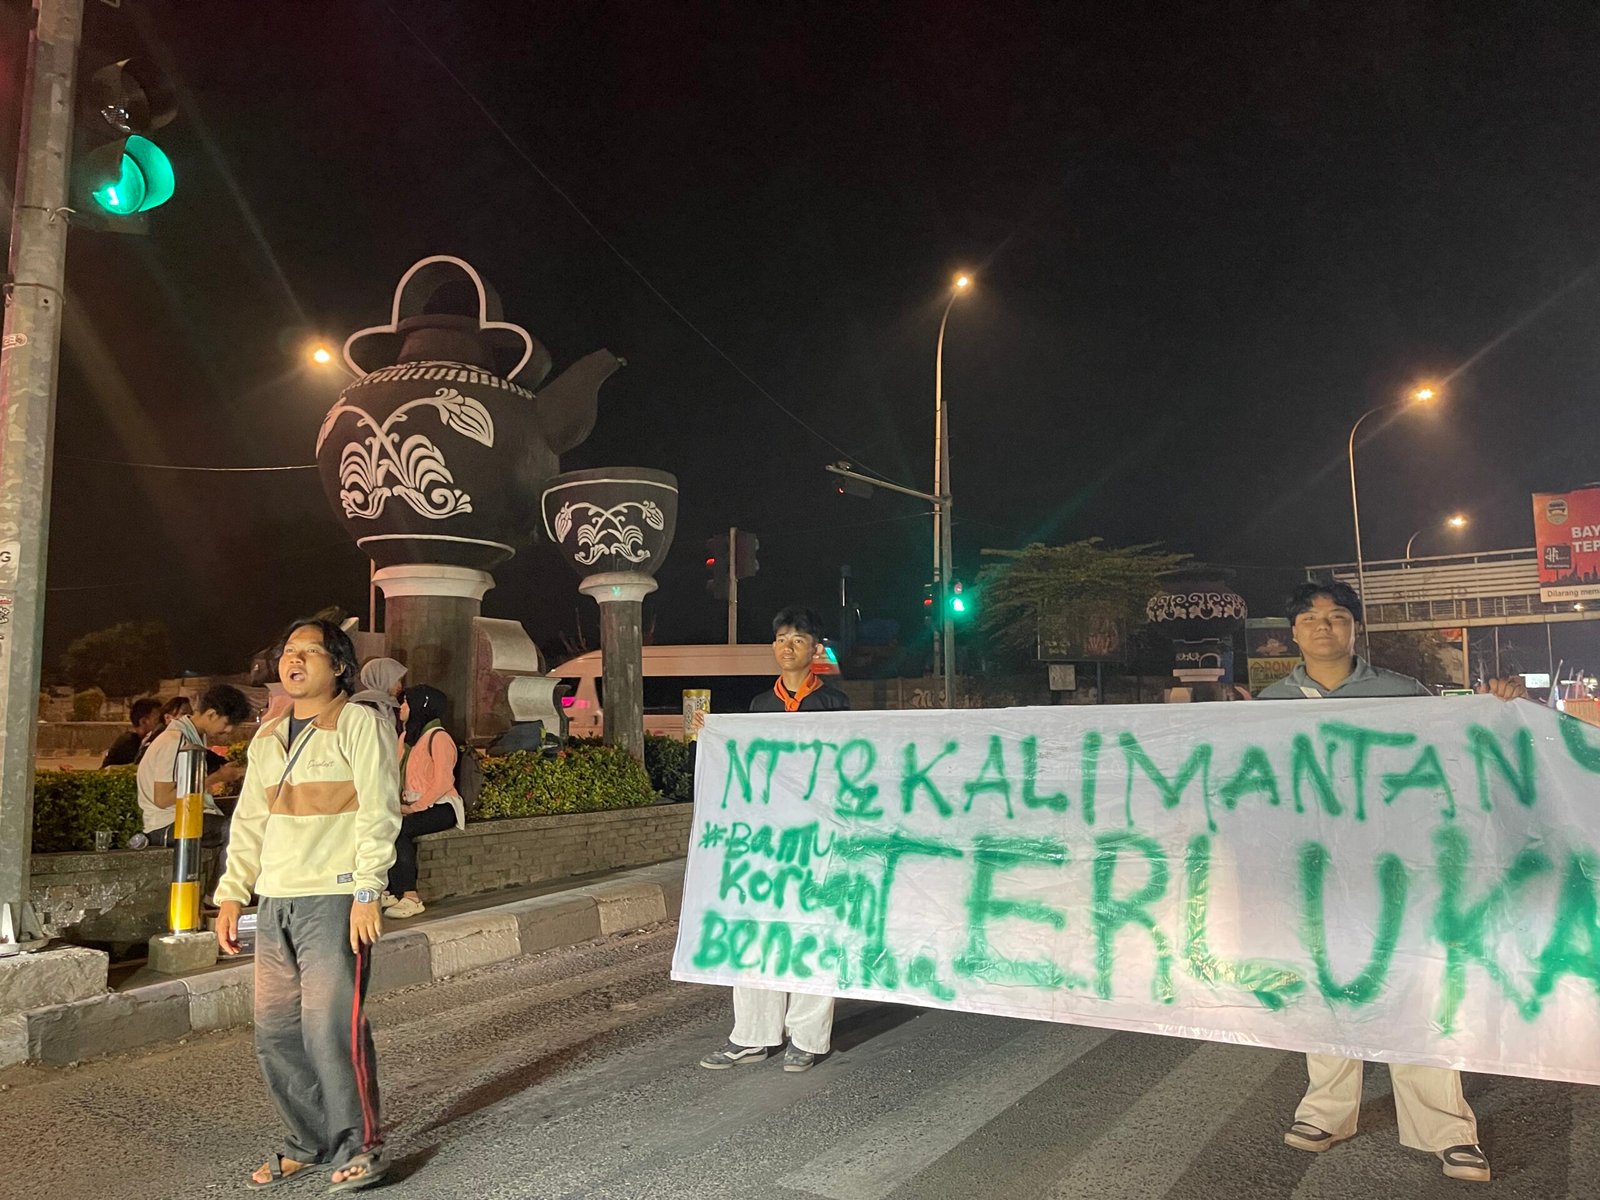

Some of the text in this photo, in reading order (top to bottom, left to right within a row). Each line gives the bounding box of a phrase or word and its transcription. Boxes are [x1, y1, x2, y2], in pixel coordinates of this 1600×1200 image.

[1571, 525, 1600, 539] BAY
[1547, 588, 1600, 598] Dilarang mem
[899, 719, 1537, 831] KALIMANTAN
